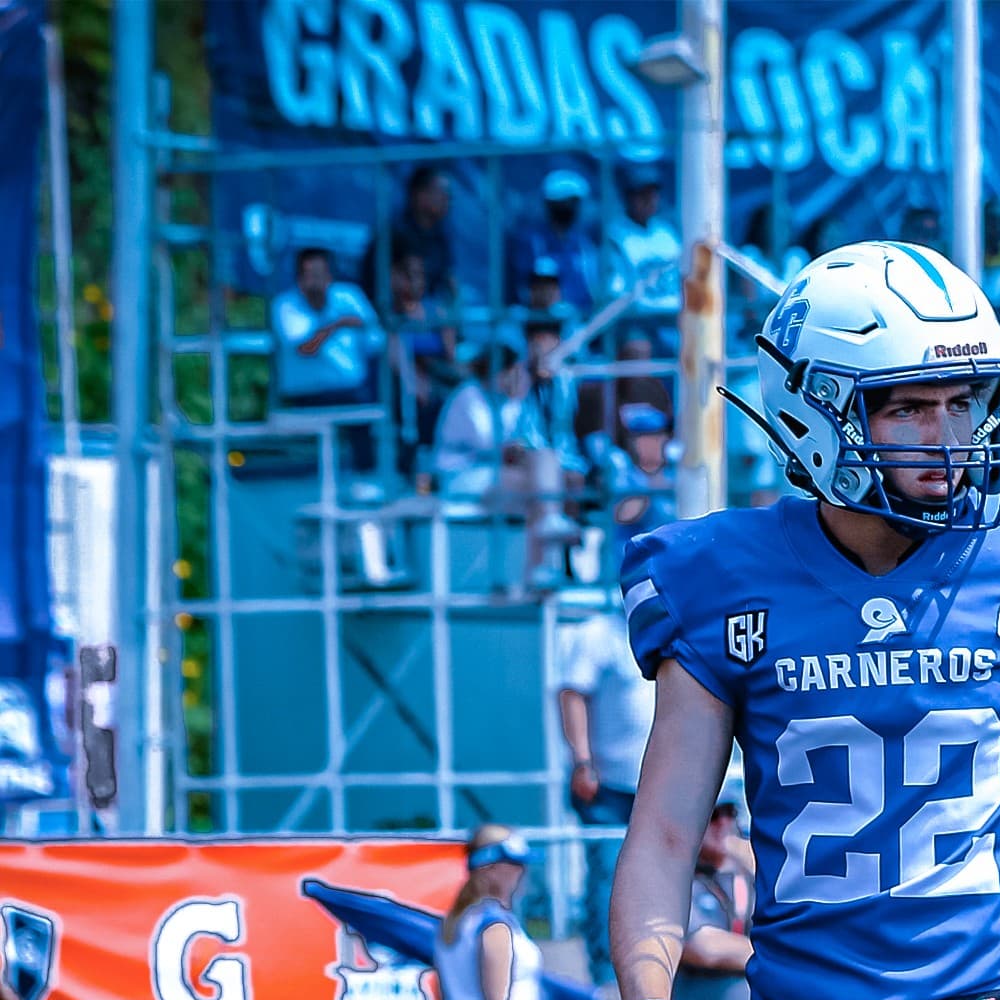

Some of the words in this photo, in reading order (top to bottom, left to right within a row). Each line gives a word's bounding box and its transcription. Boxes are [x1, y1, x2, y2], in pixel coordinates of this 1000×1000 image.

[262, 0, 664, 162] GRADAS
[725, 27, 952, 176] OCA
[934, 341, 988, 358] Riddell
[842, 422, 865, 445] Rid
[922, 508, 957, 521] Riddl
[728, 611, 765, 662] GK
[775, 646, 997, 692] CARNEROS
